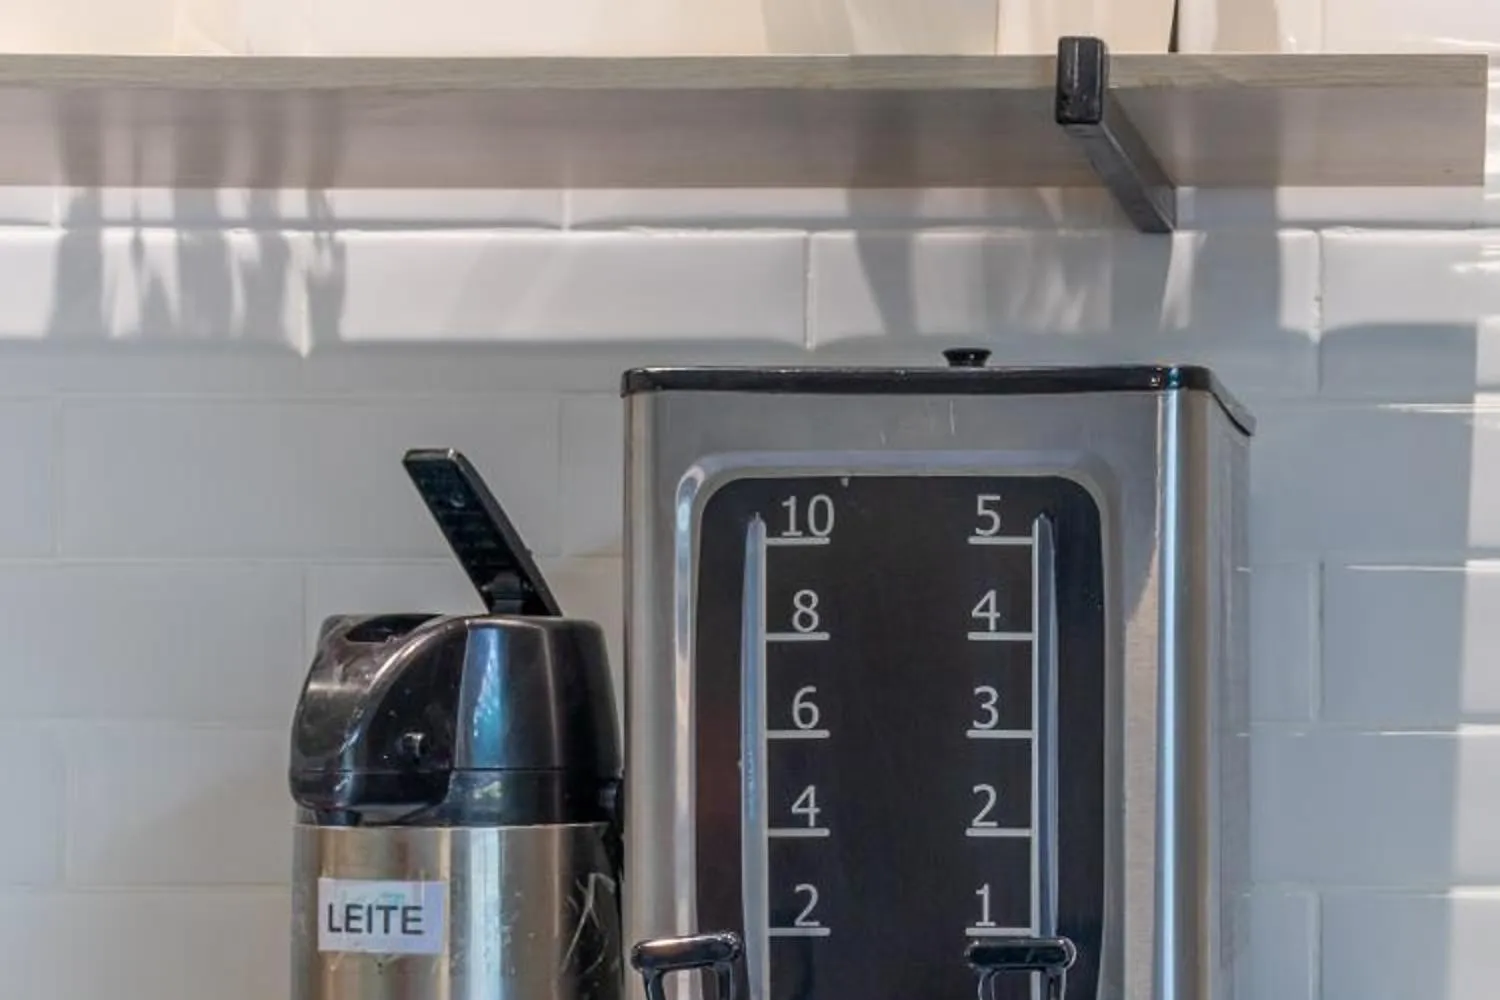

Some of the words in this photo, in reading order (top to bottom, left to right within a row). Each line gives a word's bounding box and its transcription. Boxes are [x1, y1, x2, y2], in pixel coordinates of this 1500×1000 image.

[780, 494, 835, 537] 10
[974, 494, 1001, 536] 5
[791, 589, 820, 632] 8
[970, 589, 1001, 631] 4
[791, 686, 820, 730] 6
[971, 686, 999, 730] 3
[790, 785, 821, 828] 4
[971, 785, 999, 828] 2
[327, 903, 425, 935] LEITE
[793, 883, 821, 927] 2
[975, 883, 997, 927] 1
